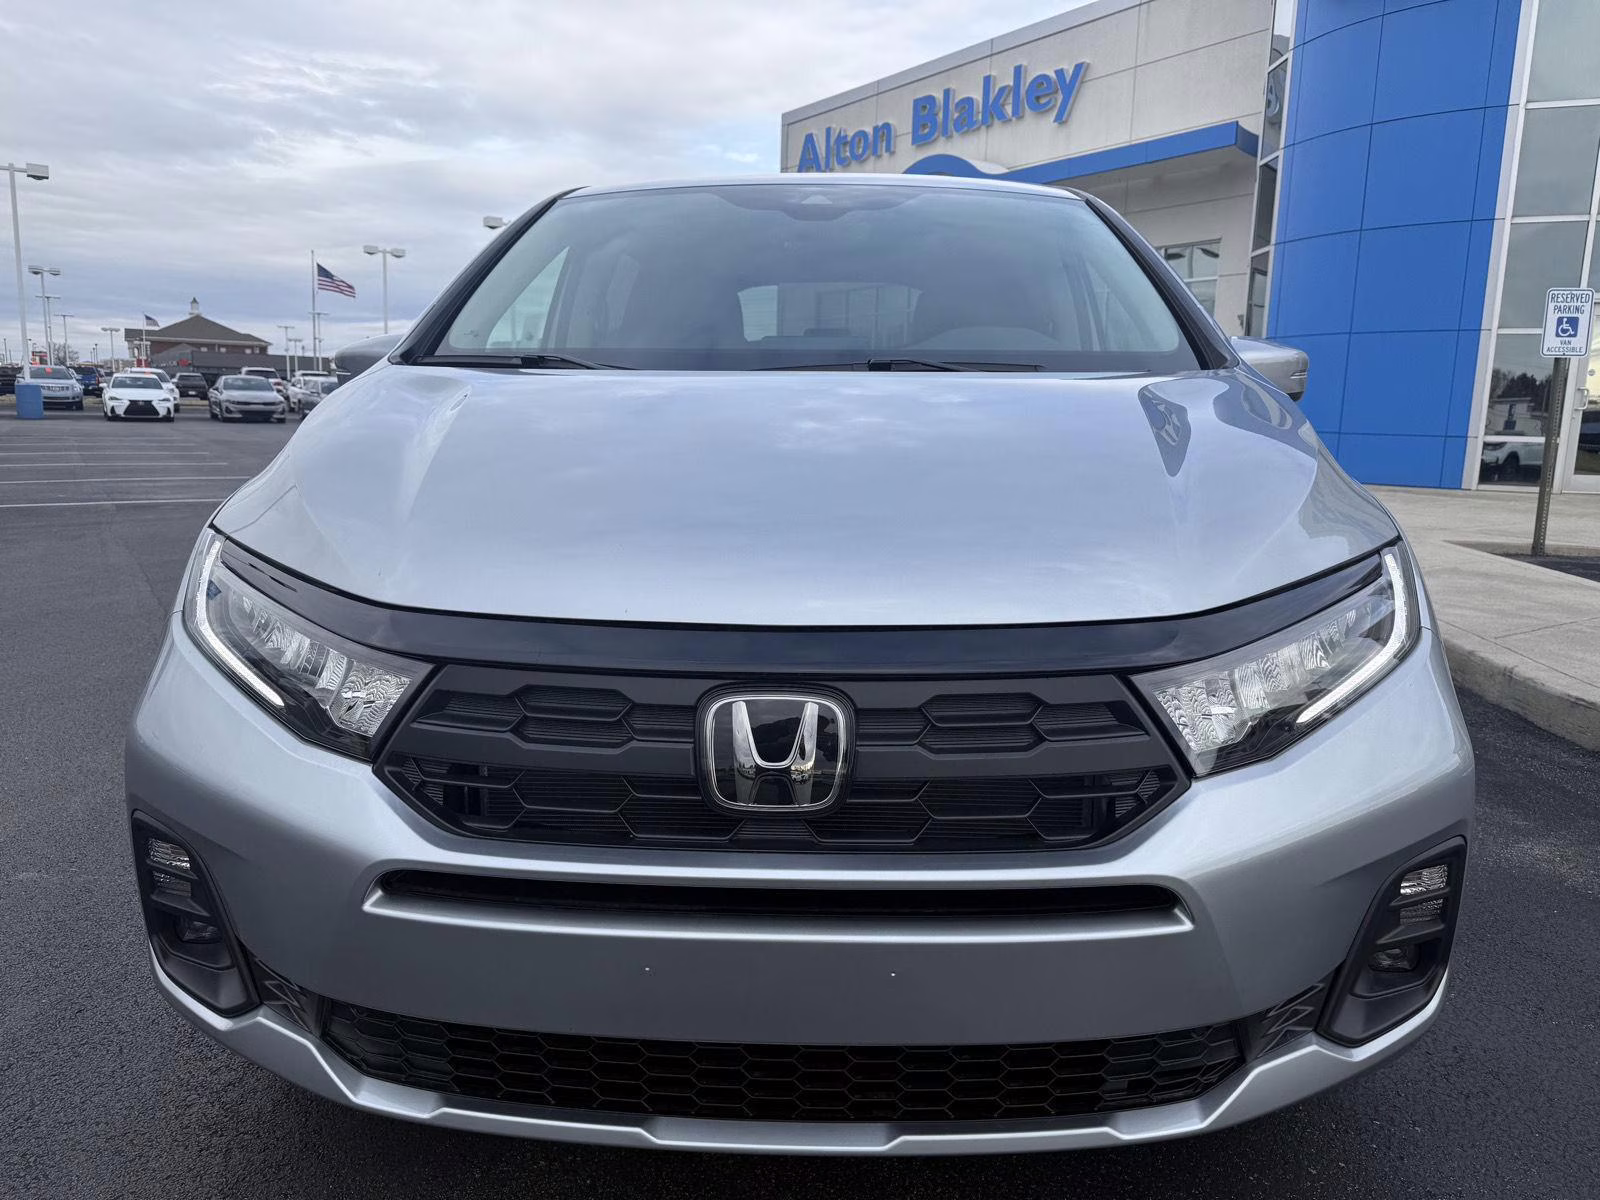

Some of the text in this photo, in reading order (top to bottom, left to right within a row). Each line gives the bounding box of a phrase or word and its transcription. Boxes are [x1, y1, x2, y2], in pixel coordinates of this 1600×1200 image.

[798, 61, 1091, 173] Alton Blakley
[1550, 292, 1591, 304] RESERVED
[1553, 304, 1585, 315] PARKING
